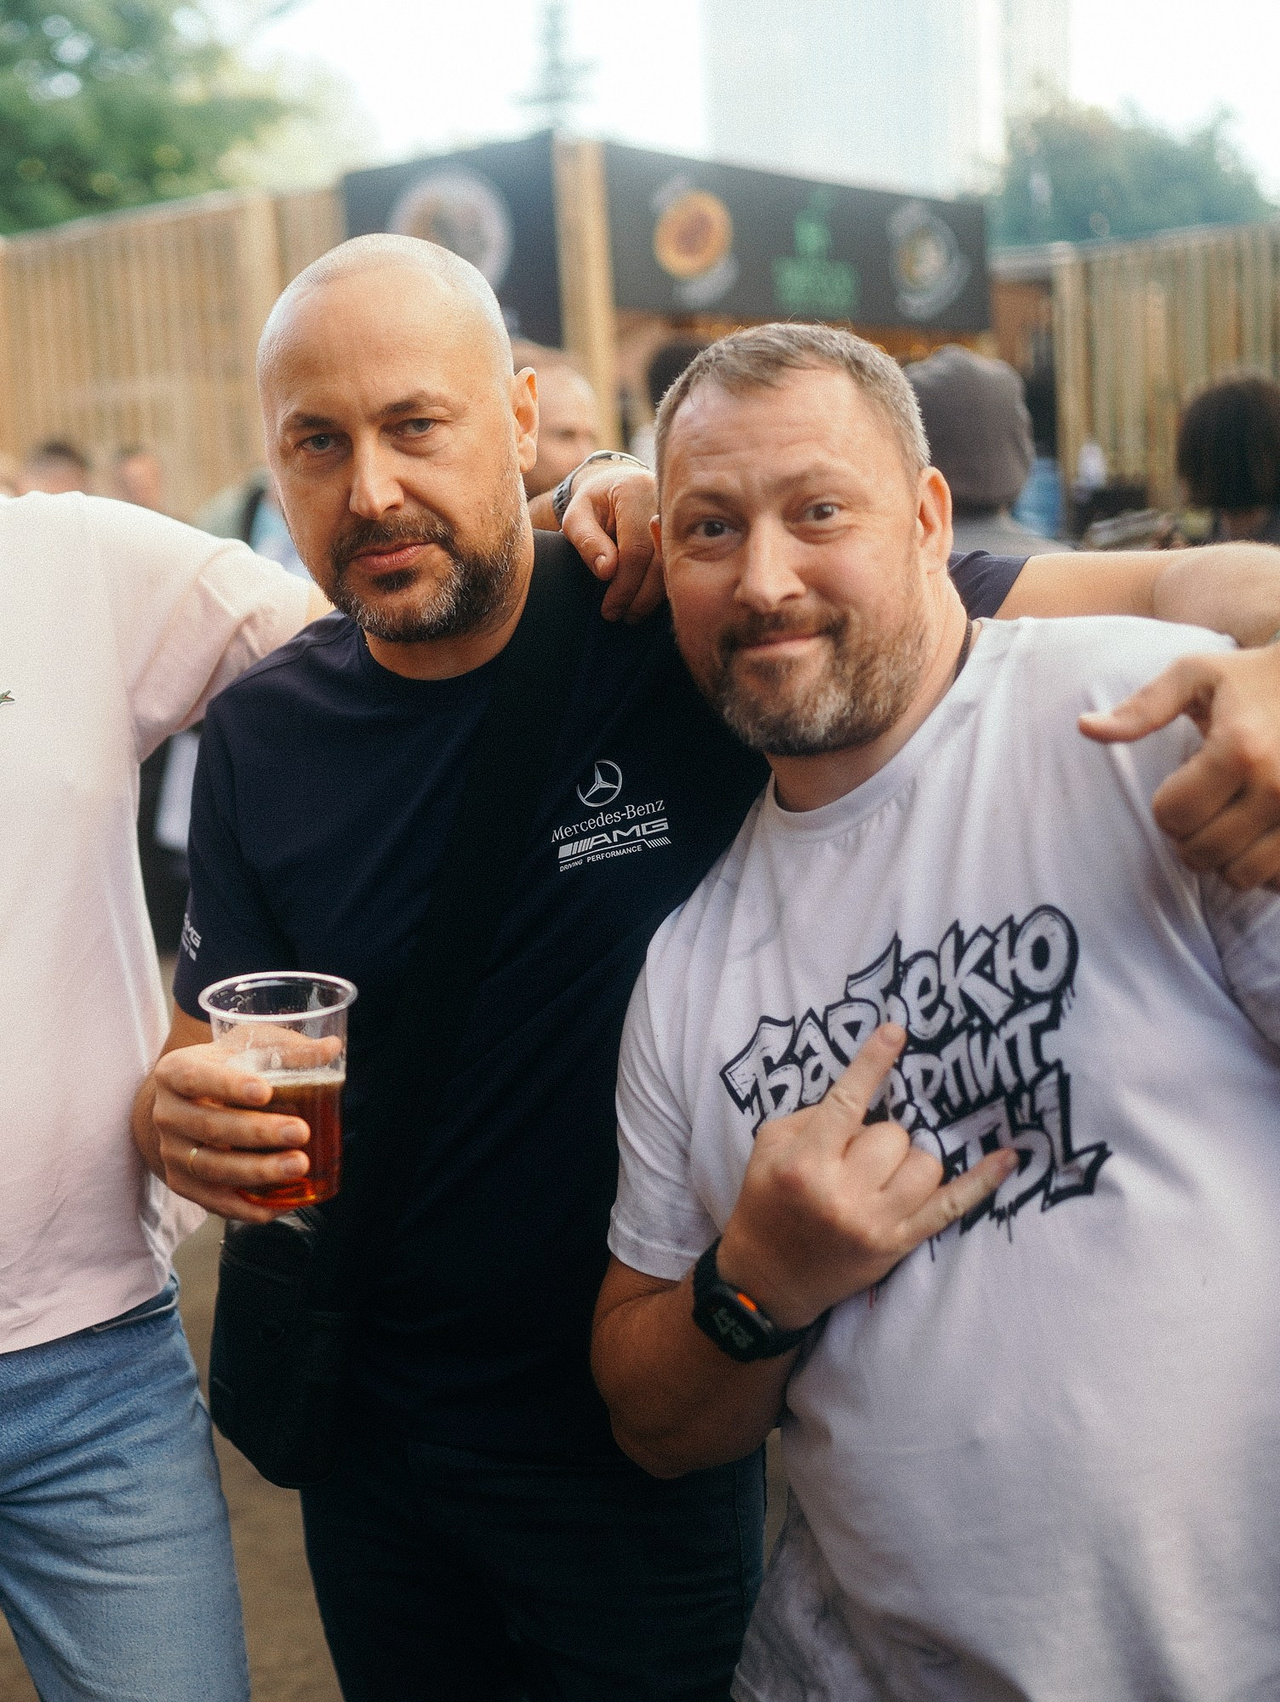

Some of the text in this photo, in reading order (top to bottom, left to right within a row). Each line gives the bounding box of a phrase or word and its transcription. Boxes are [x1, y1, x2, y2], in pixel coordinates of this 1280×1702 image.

[551, 800, 665, 842] Mercedes-Benz
[587, 818, 669, 850] AMG
[559, 844, 642, 872] DRIVING PERFORMANCE
